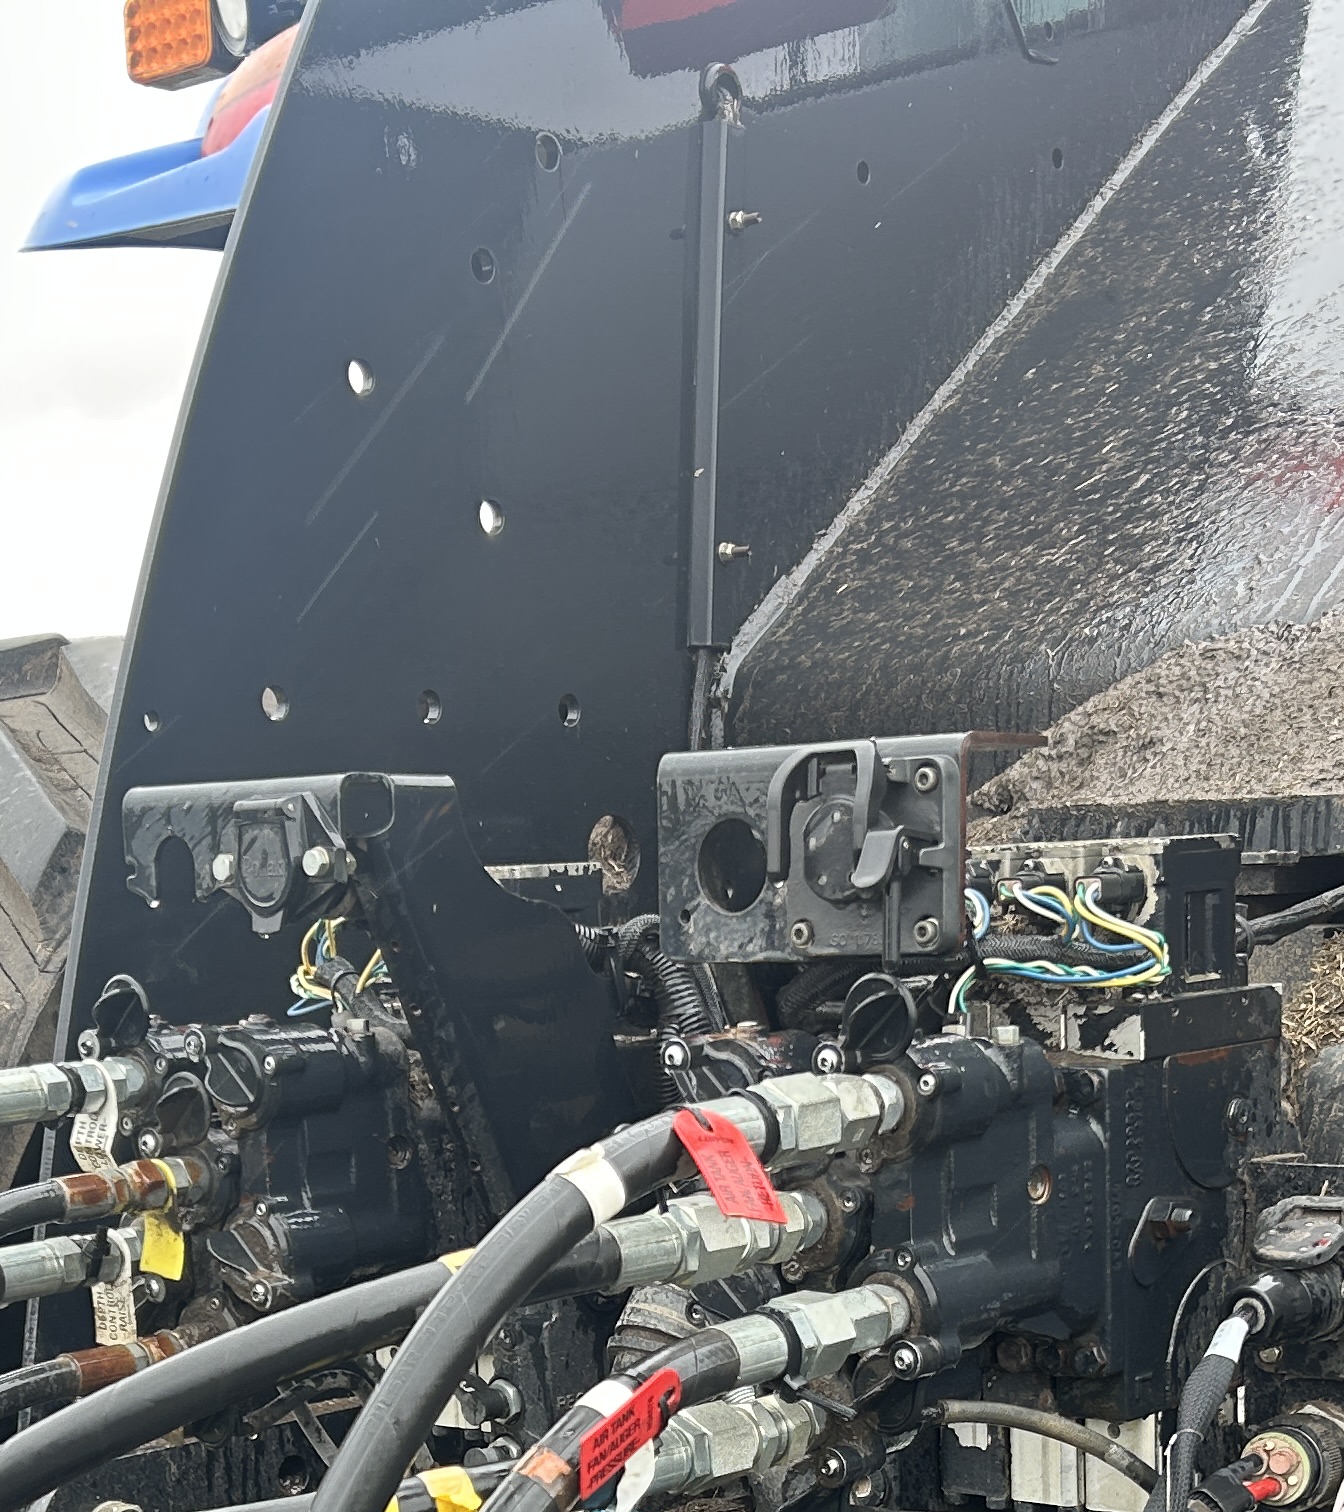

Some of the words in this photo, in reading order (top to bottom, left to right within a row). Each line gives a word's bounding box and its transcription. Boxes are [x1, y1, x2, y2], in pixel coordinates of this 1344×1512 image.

[700, 1153, 726, 1182] TANK
[718, 1184, 740, 1205] AIR
[586, 1417, 641, 1475] FAN/AUGER
[592, 1428, 609, 1454] AIR
[611, 1405, 636, 1434] TANK
